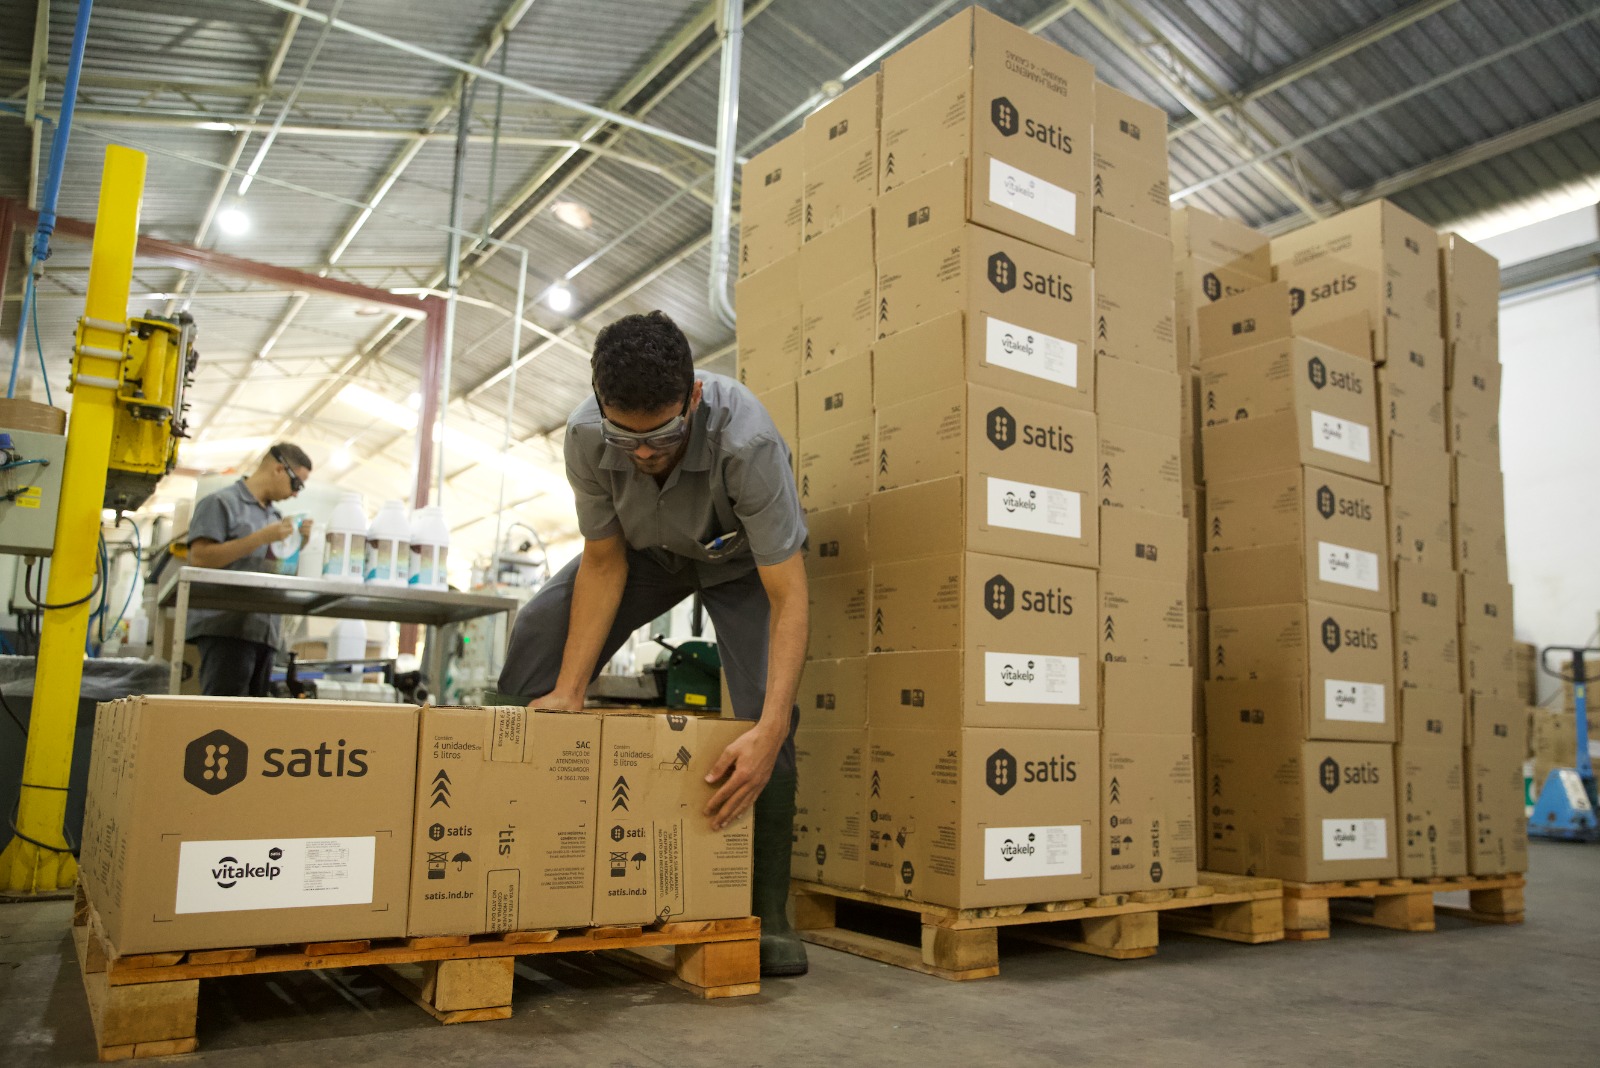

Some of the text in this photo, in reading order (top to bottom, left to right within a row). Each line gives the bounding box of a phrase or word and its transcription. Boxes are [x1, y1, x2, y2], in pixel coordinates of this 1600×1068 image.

[1005, 60, 1067, 97] EMPILHAMENTO
[1025, 118, 1073, 154] satis
[1023, 270, 1073, 302] satis
[1310, 274, 1356, 302] satis
[1002, 338, 1034, 356] vitakelp
[1330, 370, 1362, 394] satis
[1022, 424, 1074, 454] satis
[1002, 496, 1036, 511] vitakelp
[1338, 498, 1372, 520] satis
[1022, 588, 1073, 616] satis
[1344, 627, 1378, 650] satis
[1000, 670, 1034, 683] vitakelp
[434, 742, 440, 750] 4
[442, 742, 476, 750] unidades
[440, 750, 461, 759] litros
[620, 750, 650, 758] unidades
[262, 739, 368, 778] satis
[620, 758, 638, 766] litros
[1024, 754, 1076, 782] satis
[1344, 762, 1379, 784] satis
[447, 826, 472, 836] satis
[626, 828, 646, 838] sati
[499, 830, 514, 856] tis
[1000, 844, 1035, 856] vitakelp
[659, 850, 663, 858] DO
[211, 862, 281, 880] vitakelp
[424, 891, 474, 900] satis.ind.br
[608, 888, 647, 896] satis.ind.b
[492, 912, 496, 922] DO
